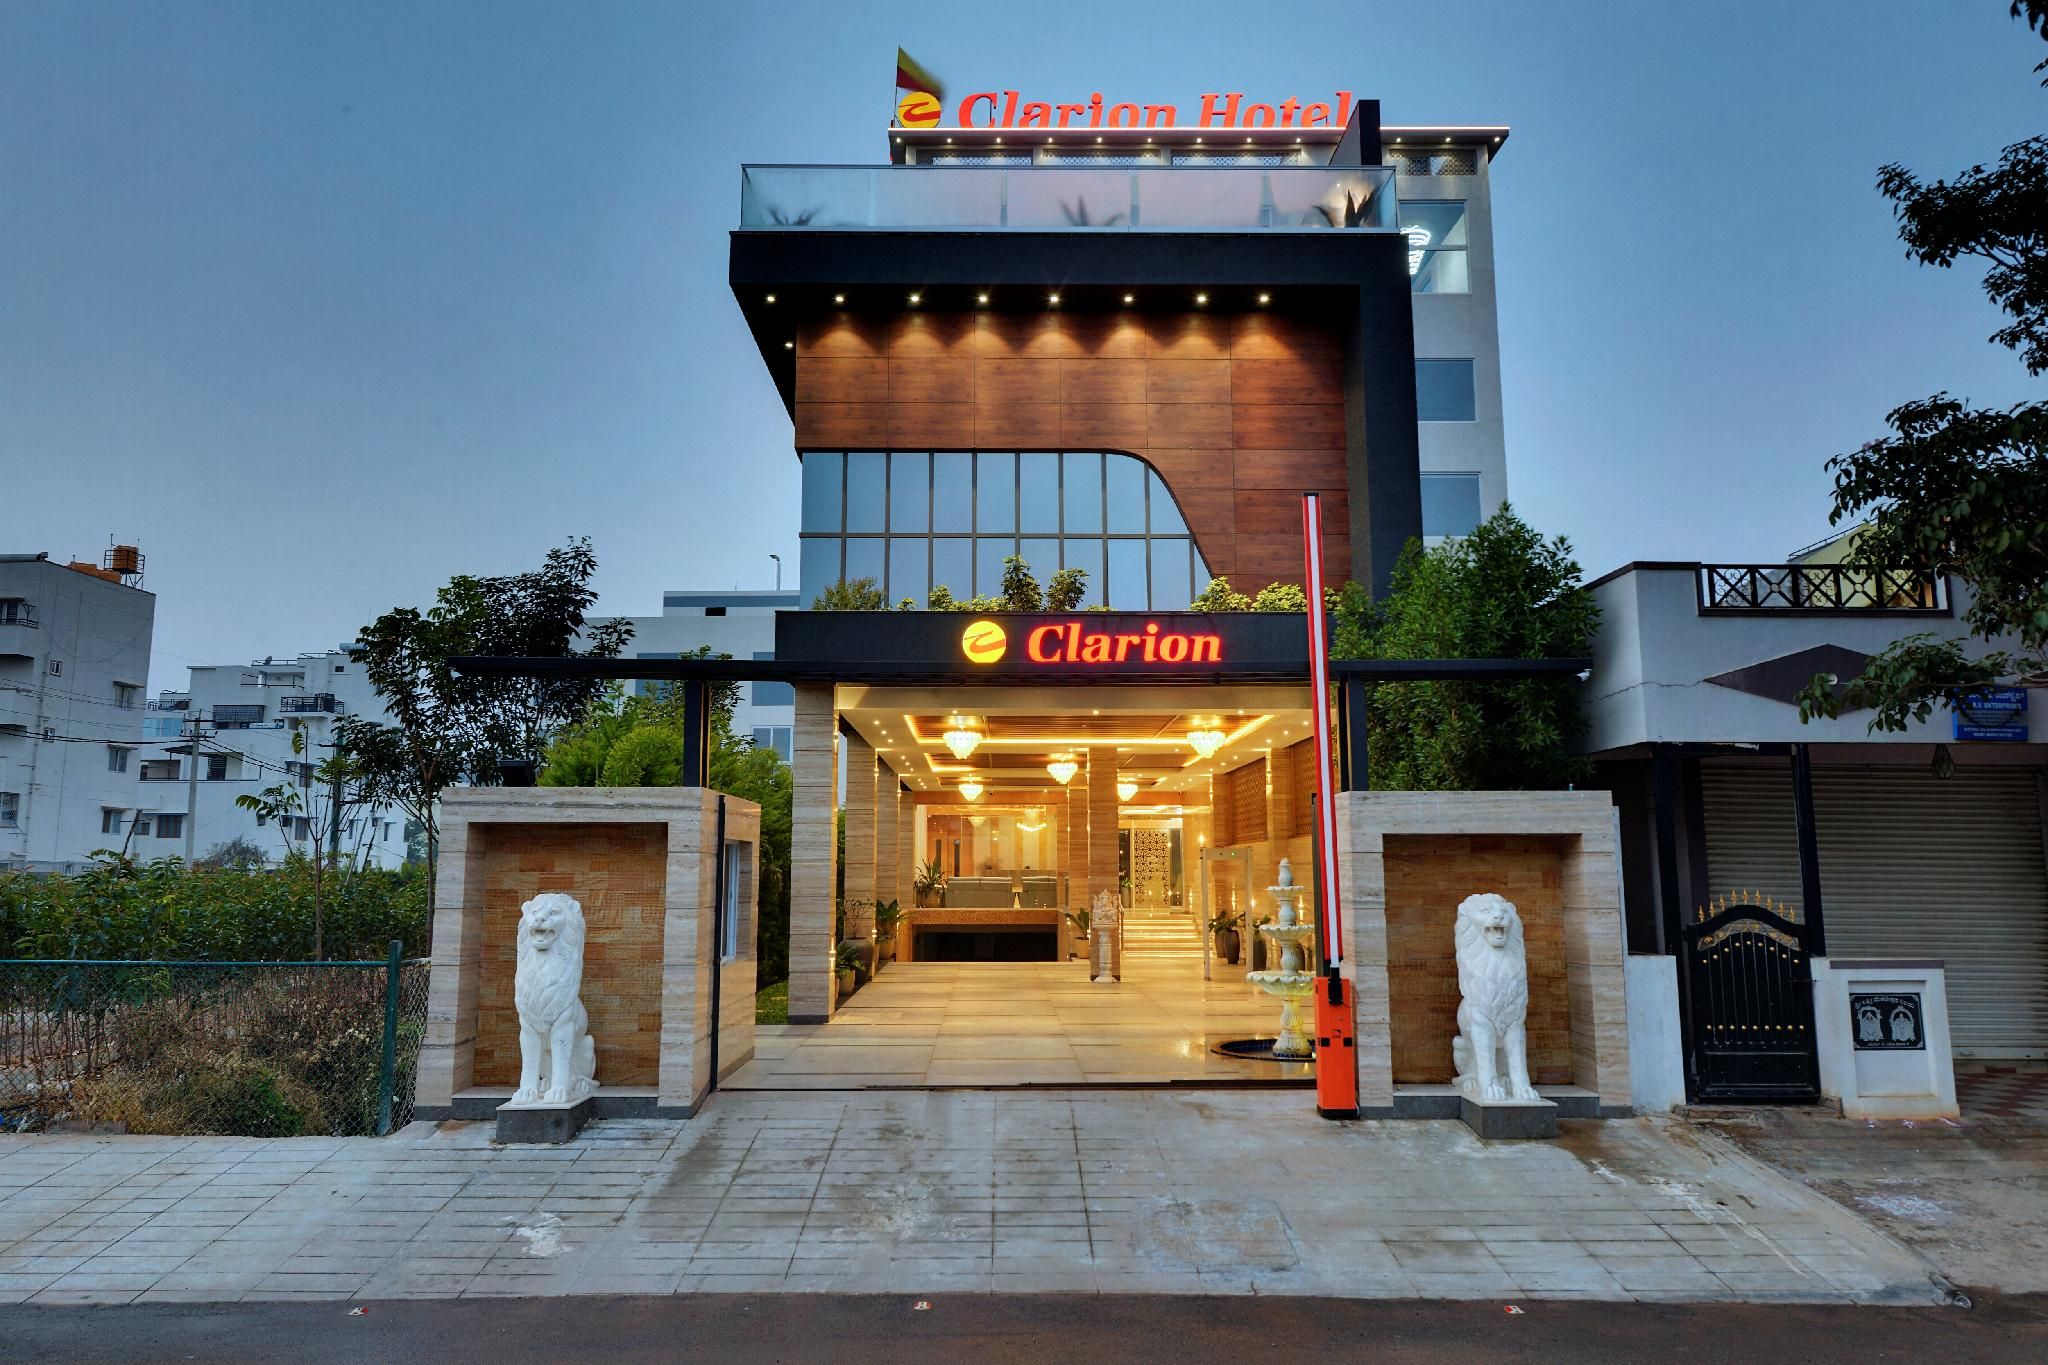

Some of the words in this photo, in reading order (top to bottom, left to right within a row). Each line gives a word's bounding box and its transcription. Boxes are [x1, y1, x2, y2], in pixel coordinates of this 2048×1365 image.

[958, 91, 1177, 128] Clarion
[1200, 90, 1353, 128] Hotel
[1028, 622, 1222, 663] Clarion
